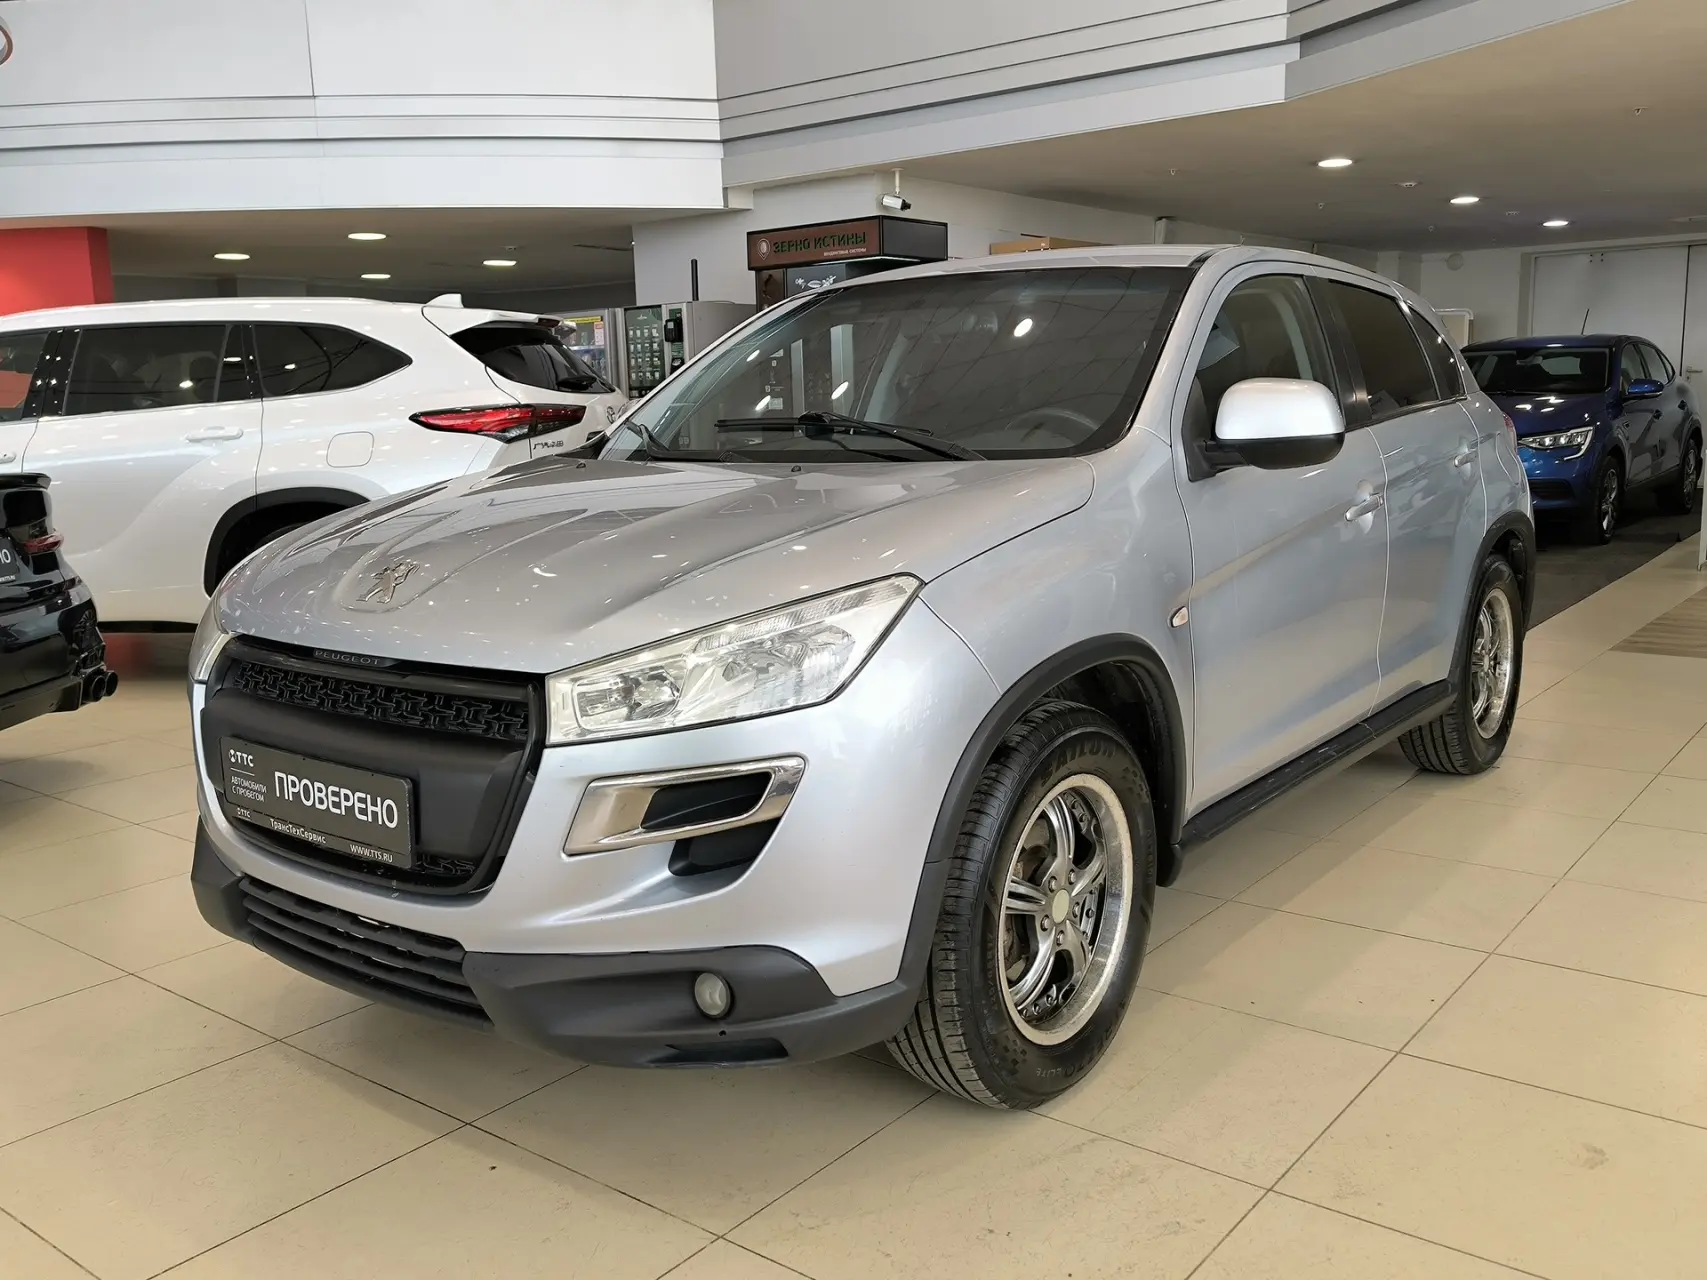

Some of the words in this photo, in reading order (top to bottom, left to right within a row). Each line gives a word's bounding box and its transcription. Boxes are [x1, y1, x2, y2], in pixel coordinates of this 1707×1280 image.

[772, 237, 811, 254] ЗЕРНО
[814, 231, 867, 249] ИСТИНЫ
[314, 649, 379, 665] PEUGEOT
[230, 776, 267, 794] АВТОМОБИЛИ
[237, 787, 265, 803] ПРОБЕГОМ
[274, 770, 398, 829] ПРОВЕРЕНО
[269, 818, 327, 845] ТрансТехСервис
[349, 844, 393, 863] WWW.TTS.RU
